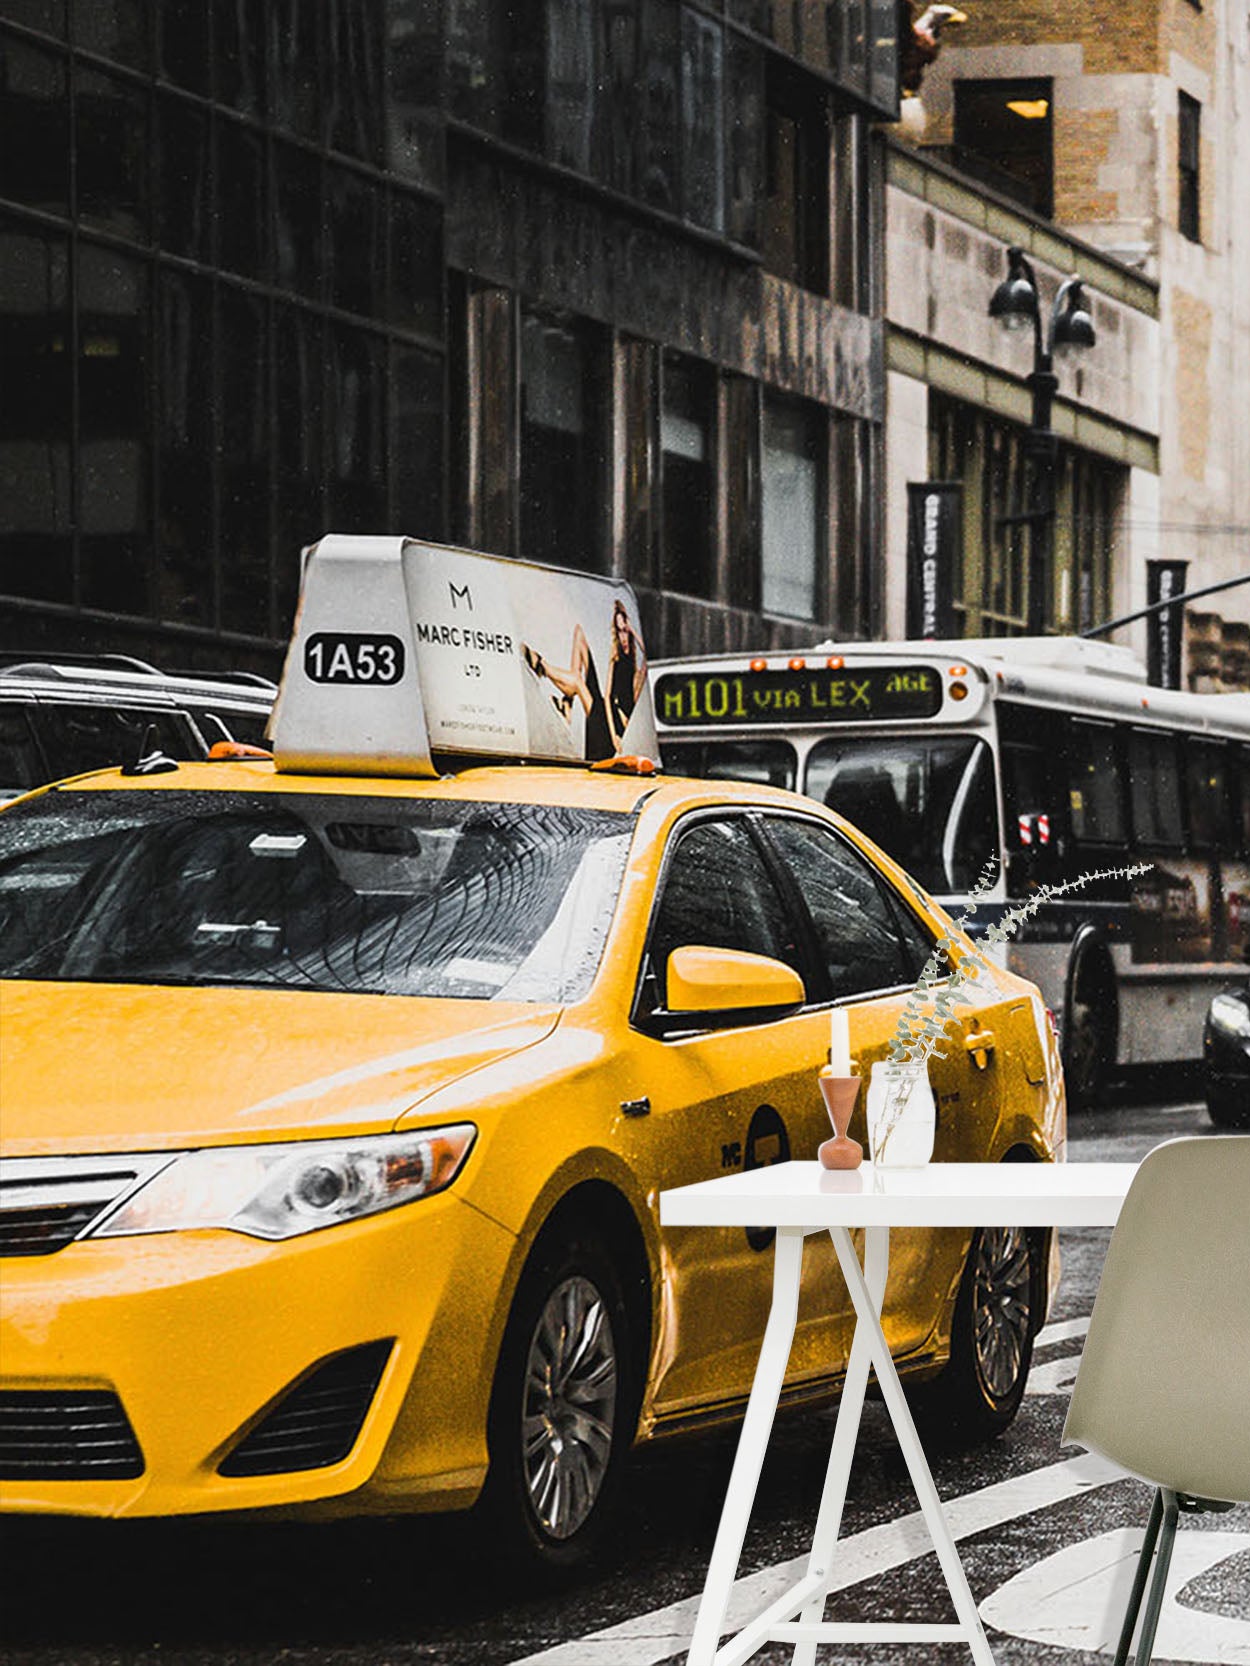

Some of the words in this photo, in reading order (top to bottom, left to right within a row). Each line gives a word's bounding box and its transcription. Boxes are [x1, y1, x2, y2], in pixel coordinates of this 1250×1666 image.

[923, 494, 939, 556] GRAND
[448, 581, 472, 611] M
[923, 558, 936, 636] CENTRAL
[1160, 569, 1172, 622] GRAD
[416, 622, 460, 647] MARC
[462, 629, 512, 655] FISHER
[309, 643, 395, 680] 1A53
[464, 664, 481, 678] LTD
[665, 678, 747, 717] M101
[753, 690, 800, 708] VIA
[811, 681, 871, 706] LEX
